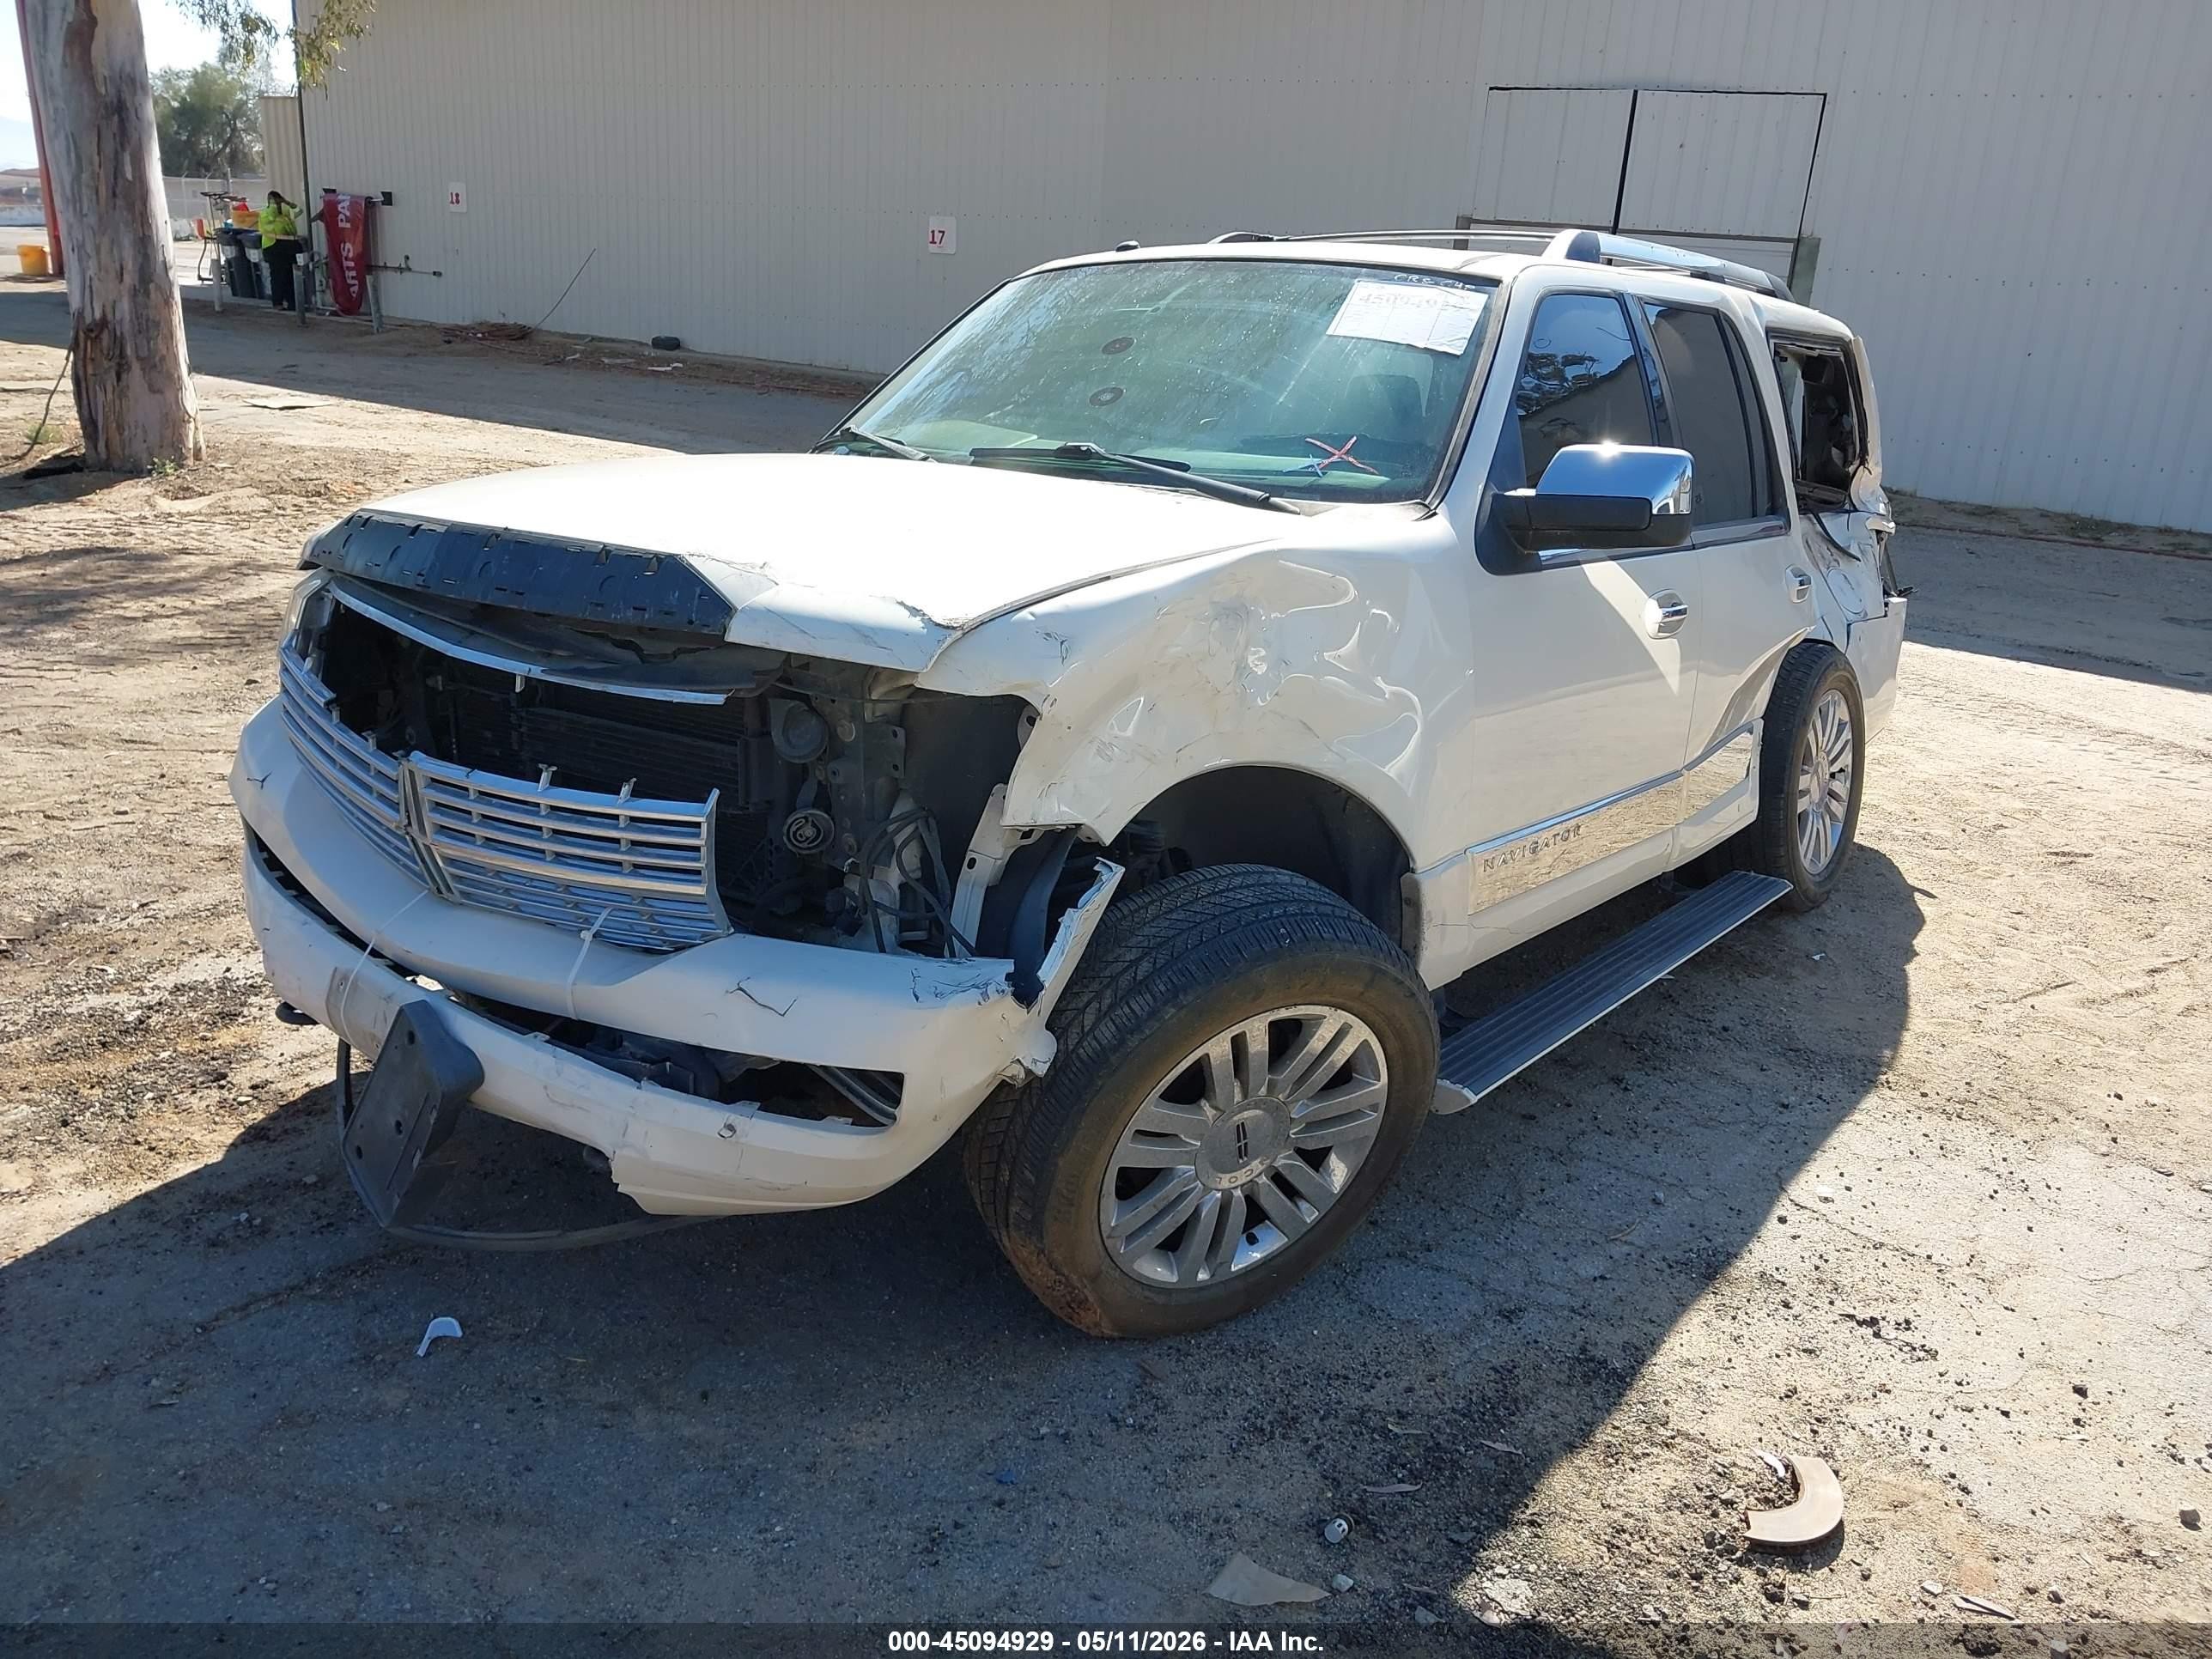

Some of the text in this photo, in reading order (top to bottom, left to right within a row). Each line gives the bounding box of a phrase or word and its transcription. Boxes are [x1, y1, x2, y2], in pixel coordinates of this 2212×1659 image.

[449, 191, 460, 205] 18
[929, 229, 945, 245] 17
[340, 241, 360, 298] ARTS
[1483, 823, 1582, 872] NAVIGATOR
